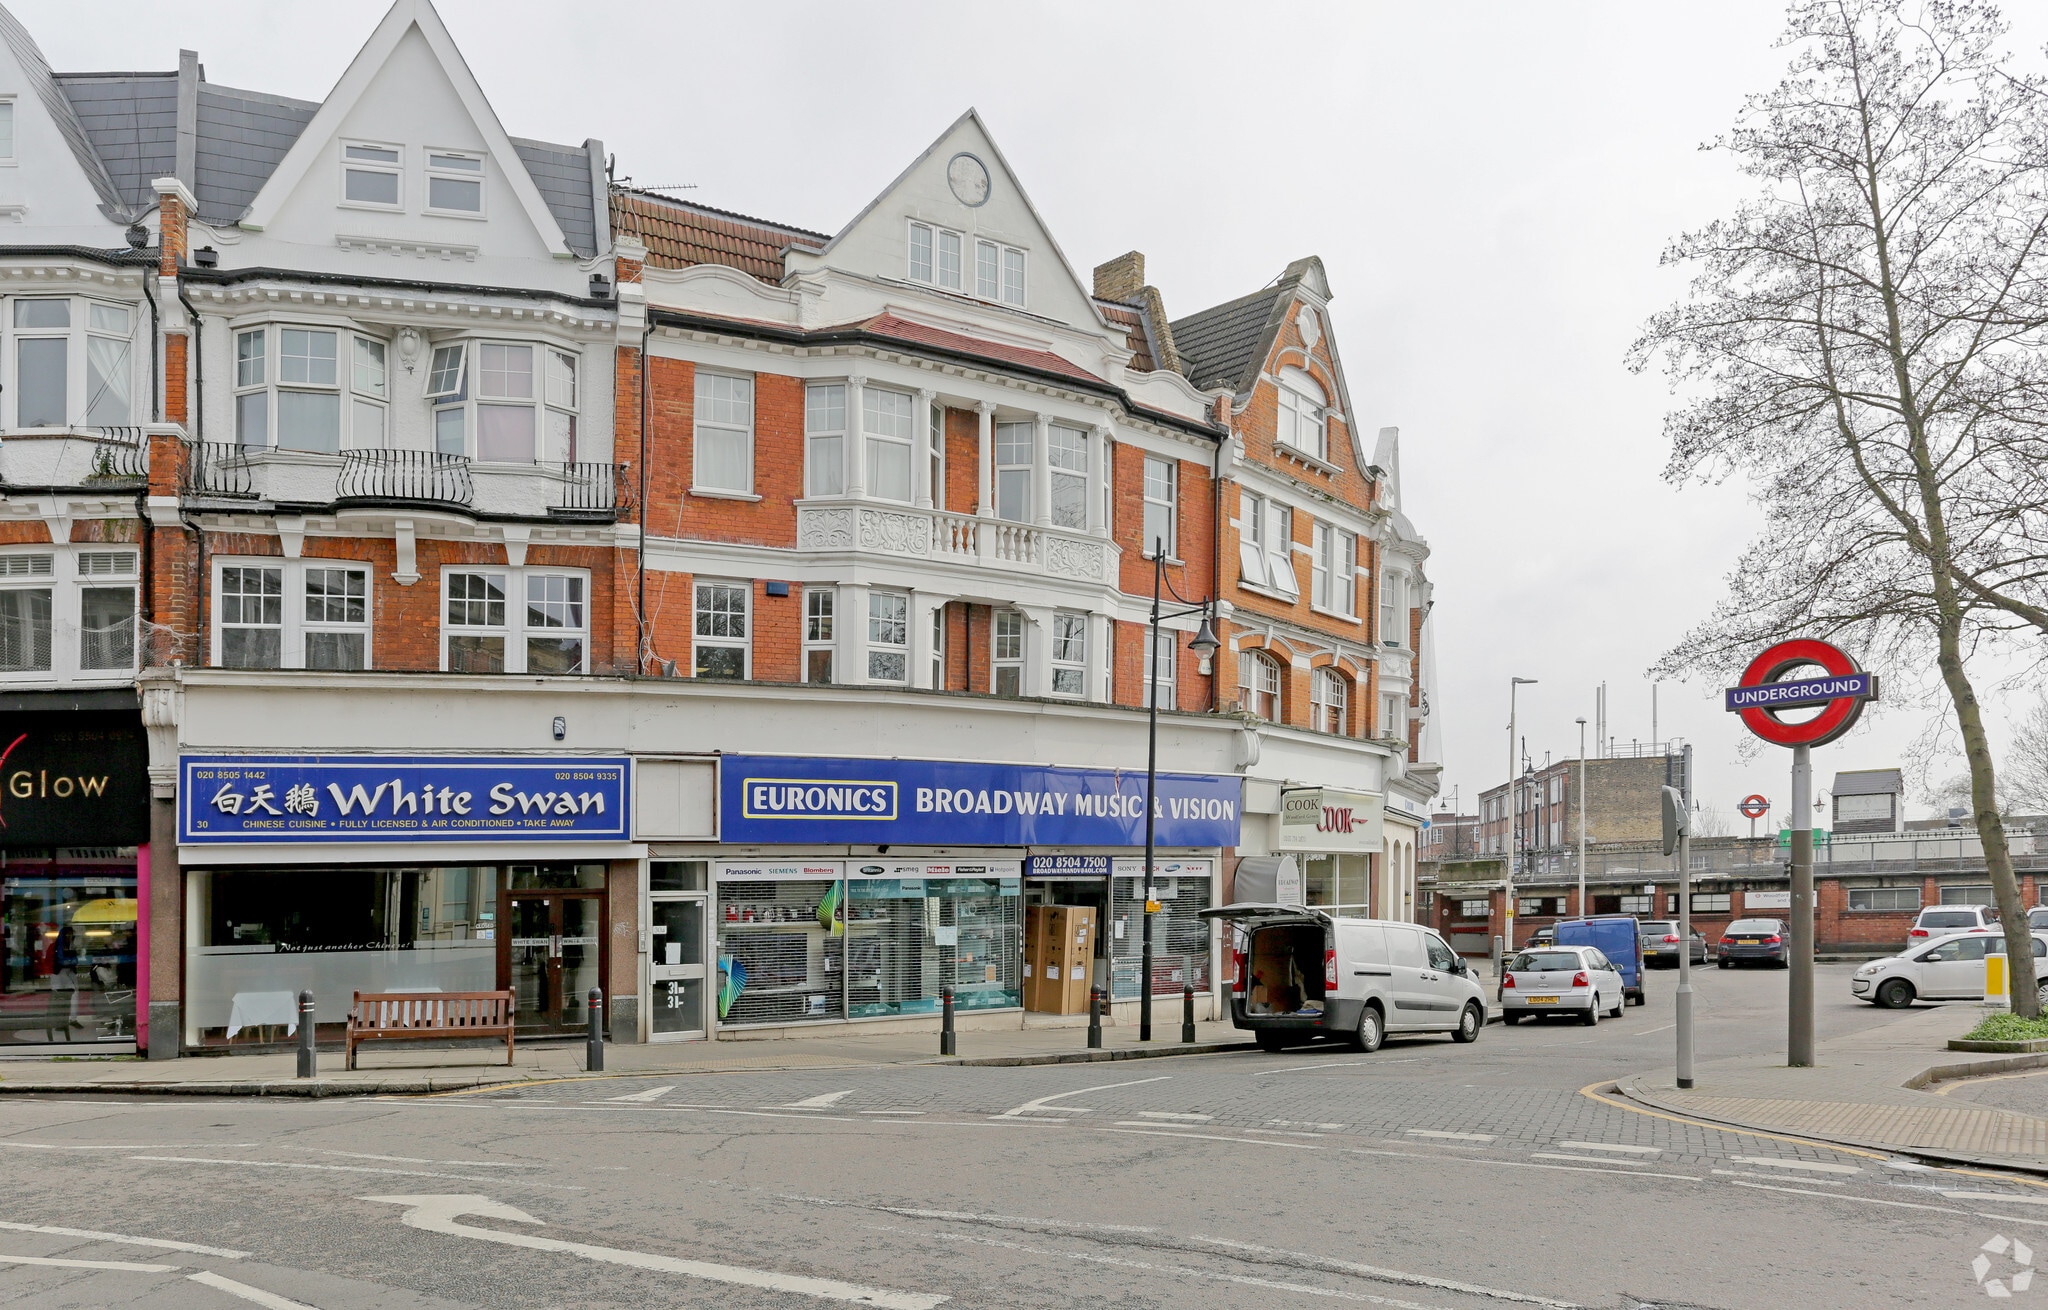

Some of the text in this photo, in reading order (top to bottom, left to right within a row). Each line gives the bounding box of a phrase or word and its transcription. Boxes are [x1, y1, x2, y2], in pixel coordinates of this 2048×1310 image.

[1734, 679, 1861, 704] UNDERGROUND
[197, 771, 265, 779] 020 8505 1442
[555, 772, 617, 781] 020 8504 9335
[9, 769, 109, 798] Glow
[327, 778, 605, 816] White Swan
[753, 786, 887, 812] EURONICS
[916, 787, 1234, 821] BROADWAY MUSIC & VISION
[1286, 799, 1319, 811] COOK
[197, 821, 208, 829] 30
[242, 819, 575, 829] CHINESE CUISINE FULLY LICENSED & AIR CONDITIONED TAKE AWAY
[1033, 857, 1107, 868] 020 8504 7500
[768, 867, 798, 875] SIEMENS
[803, 867, 834, 875] Blomberg
[280, 942, 300, 952] Not
[302, 944, 322, 952] just
[325, 942, 363, 951] another
